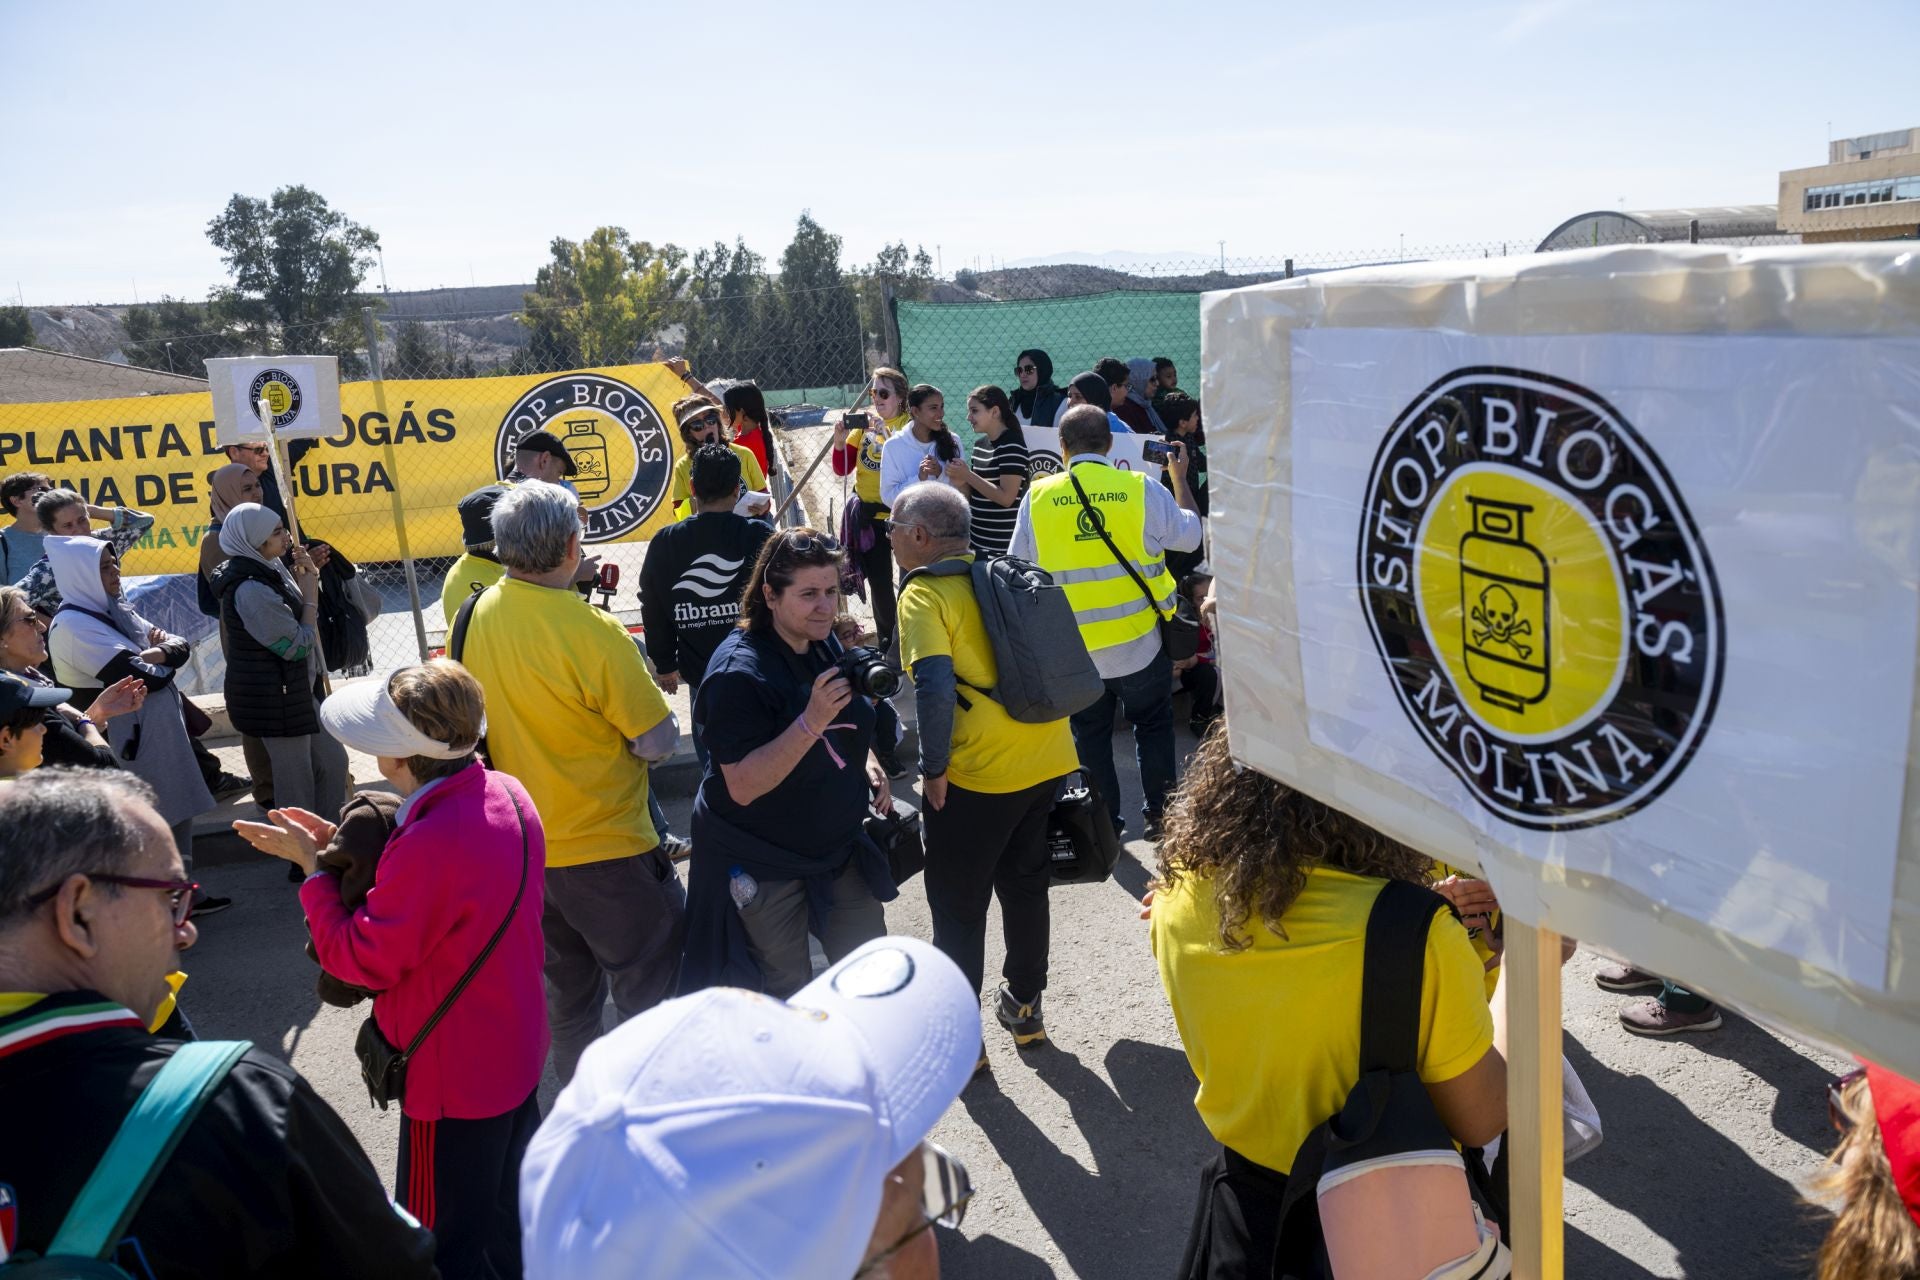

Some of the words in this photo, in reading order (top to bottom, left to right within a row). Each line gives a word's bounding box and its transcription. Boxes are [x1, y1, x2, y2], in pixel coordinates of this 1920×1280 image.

[0, 423, 191, 466] PLANTA
[572, 384, 663, 463] BIOGÁS
[135, 471, 198, 507] DE
[585, 492, 652, 535] LINA
[1373, 419, 1448, 593] STOP
[1482, 396, 1694, 664] BIOGÁS
[674, 602, 744, 621] fibram
[1413, 669, 1653, 805] MOLINA
